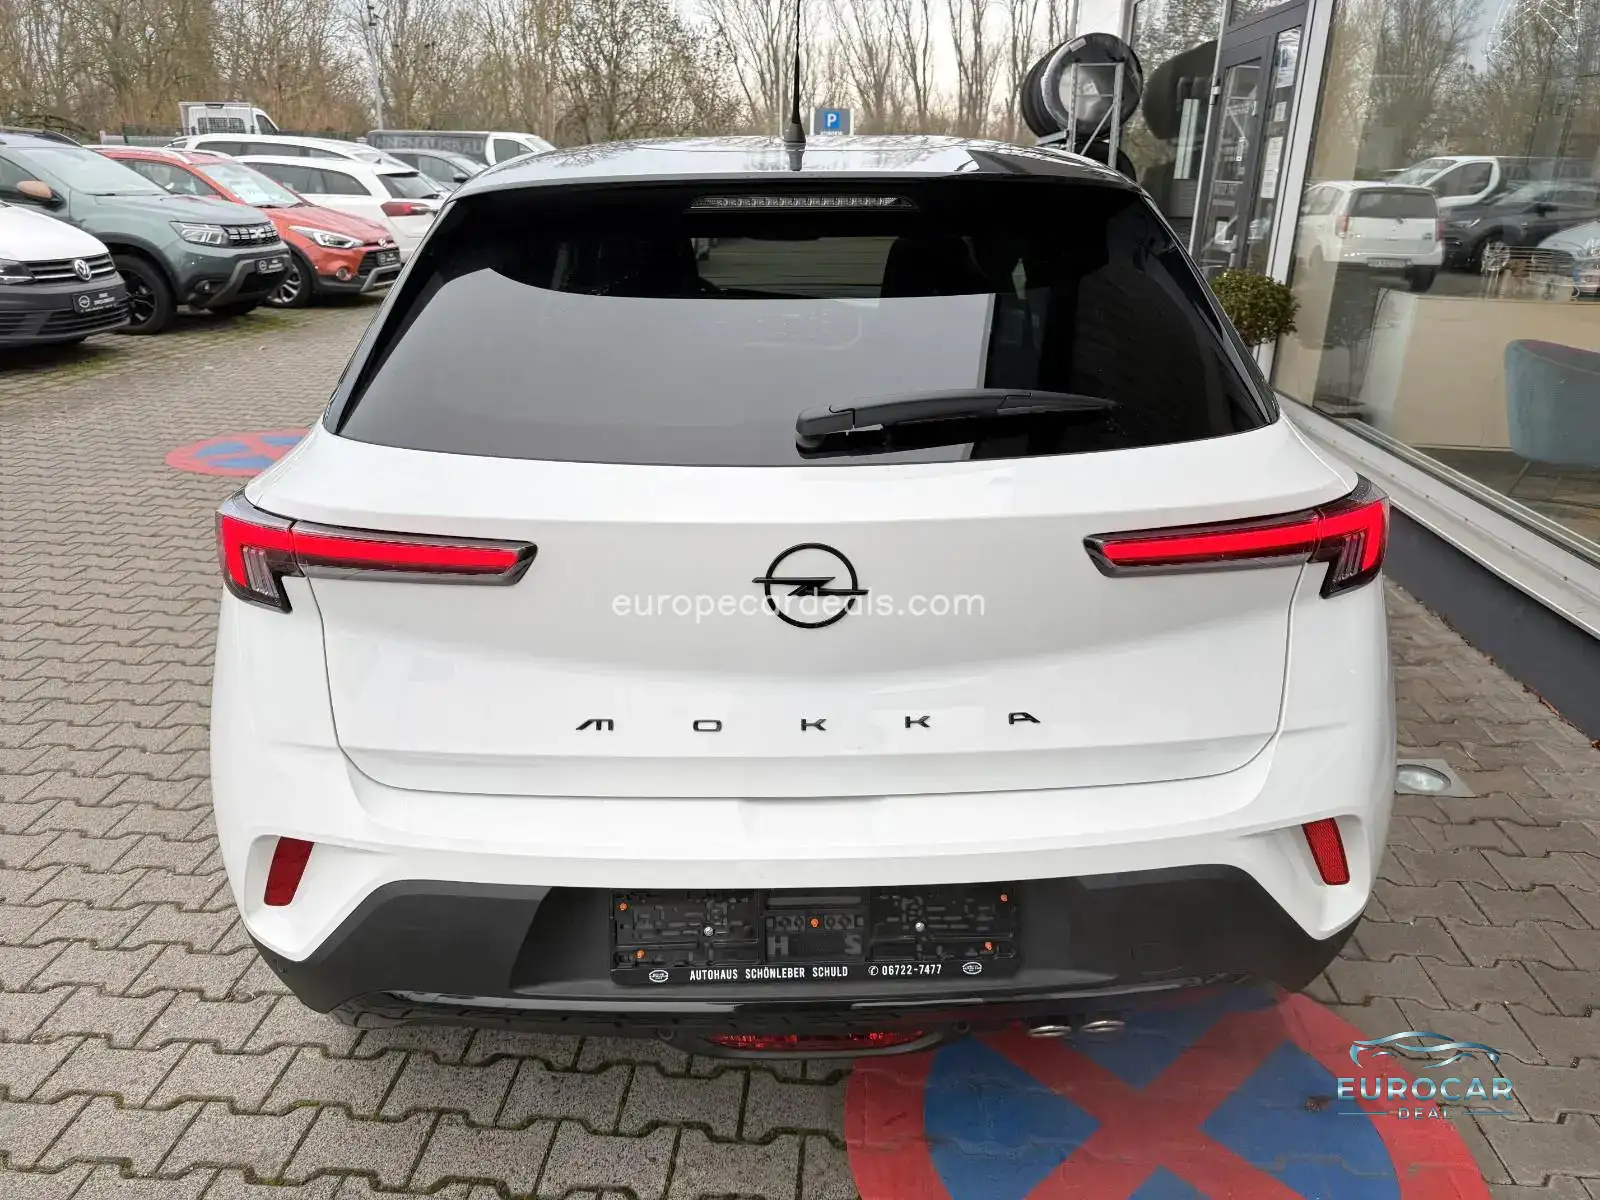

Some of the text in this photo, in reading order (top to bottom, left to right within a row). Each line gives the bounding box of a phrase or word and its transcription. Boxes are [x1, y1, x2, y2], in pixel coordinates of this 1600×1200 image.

[827, 113, 837, 127] P
[576, 711, 1041, 732] MOKKA
[689, 964, 942, 981] AUTOHAUS SCHÖNLEBER SCHULD 06722-7477
